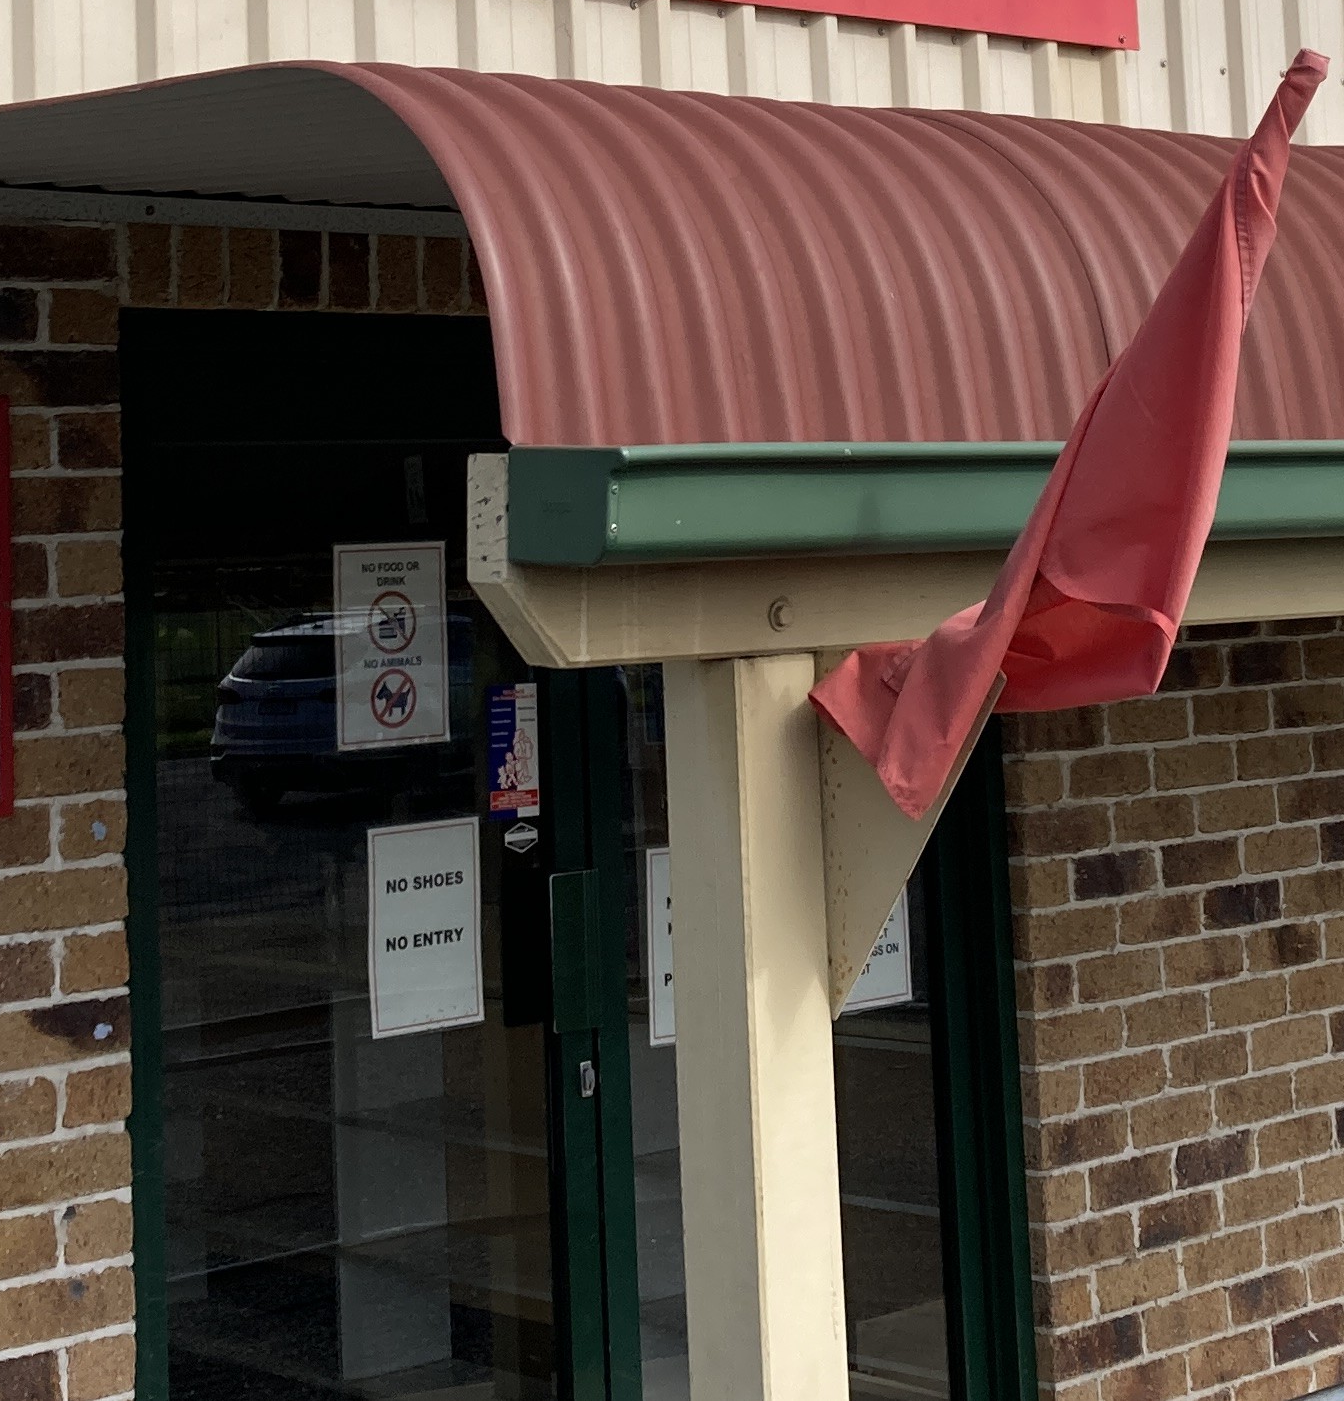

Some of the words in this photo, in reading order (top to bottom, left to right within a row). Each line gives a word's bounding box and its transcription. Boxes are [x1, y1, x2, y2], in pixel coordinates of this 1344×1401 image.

[361, 563, 376, 573] NO
[377, 561, 405, 572] FOOD
[406, 561, 420, 571] OR
[376, 576, 406, 586] DRINK
[363, 658, 377, 669] NO
[379, 656, 422, 668] ANIMALS
[386, 878, 408, 894] NO
[413, 870, 463, 890] SHOES
[386, 936, 408, 952] NO
[413, 927, 464, 948] ENTRY
